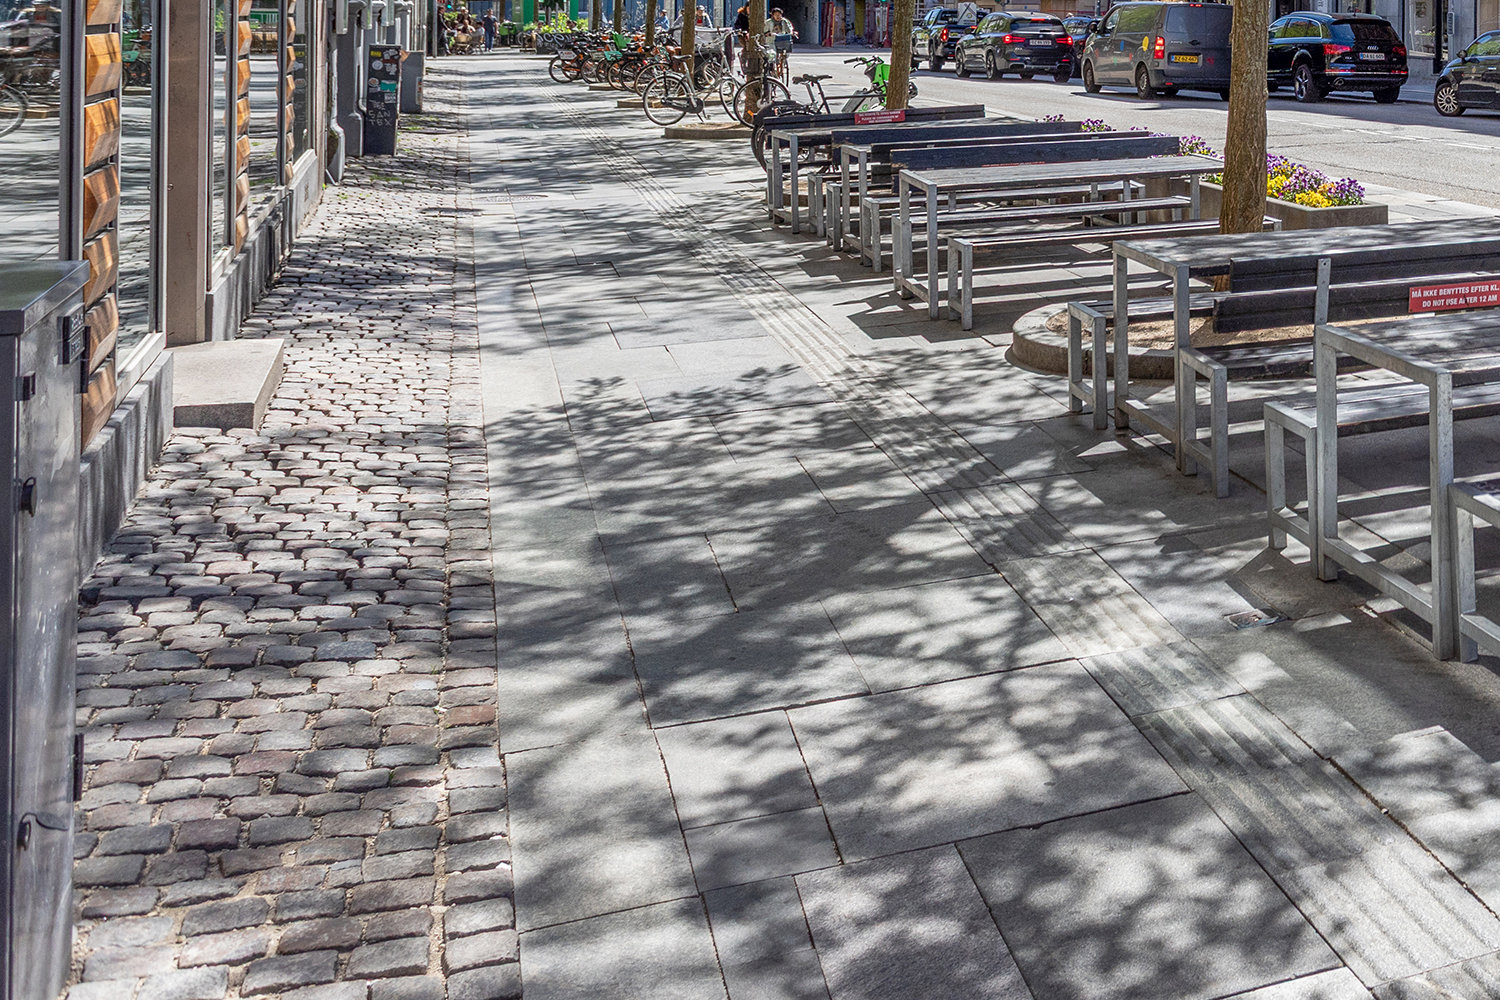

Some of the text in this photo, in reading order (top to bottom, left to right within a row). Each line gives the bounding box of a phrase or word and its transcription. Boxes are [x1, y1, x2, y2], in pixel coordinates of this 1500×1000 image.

[1412, 289, 1422, 298] MÅ
[1423, 289, 1437, 297] IKKE
[1439, 286, 1469, 296] BENYTTES
[1471, 285, 1489, 293] EFTER
[1490, 283, 1500, 292] KL.
[1422, 300, 1431, 308] DO
[1432, 299, 1444, 307] NOT
[1446, 298, 1457, 306] USE
[1479, 295, 1487, 303] 12
[1487, 294, 1498, 302] AM
